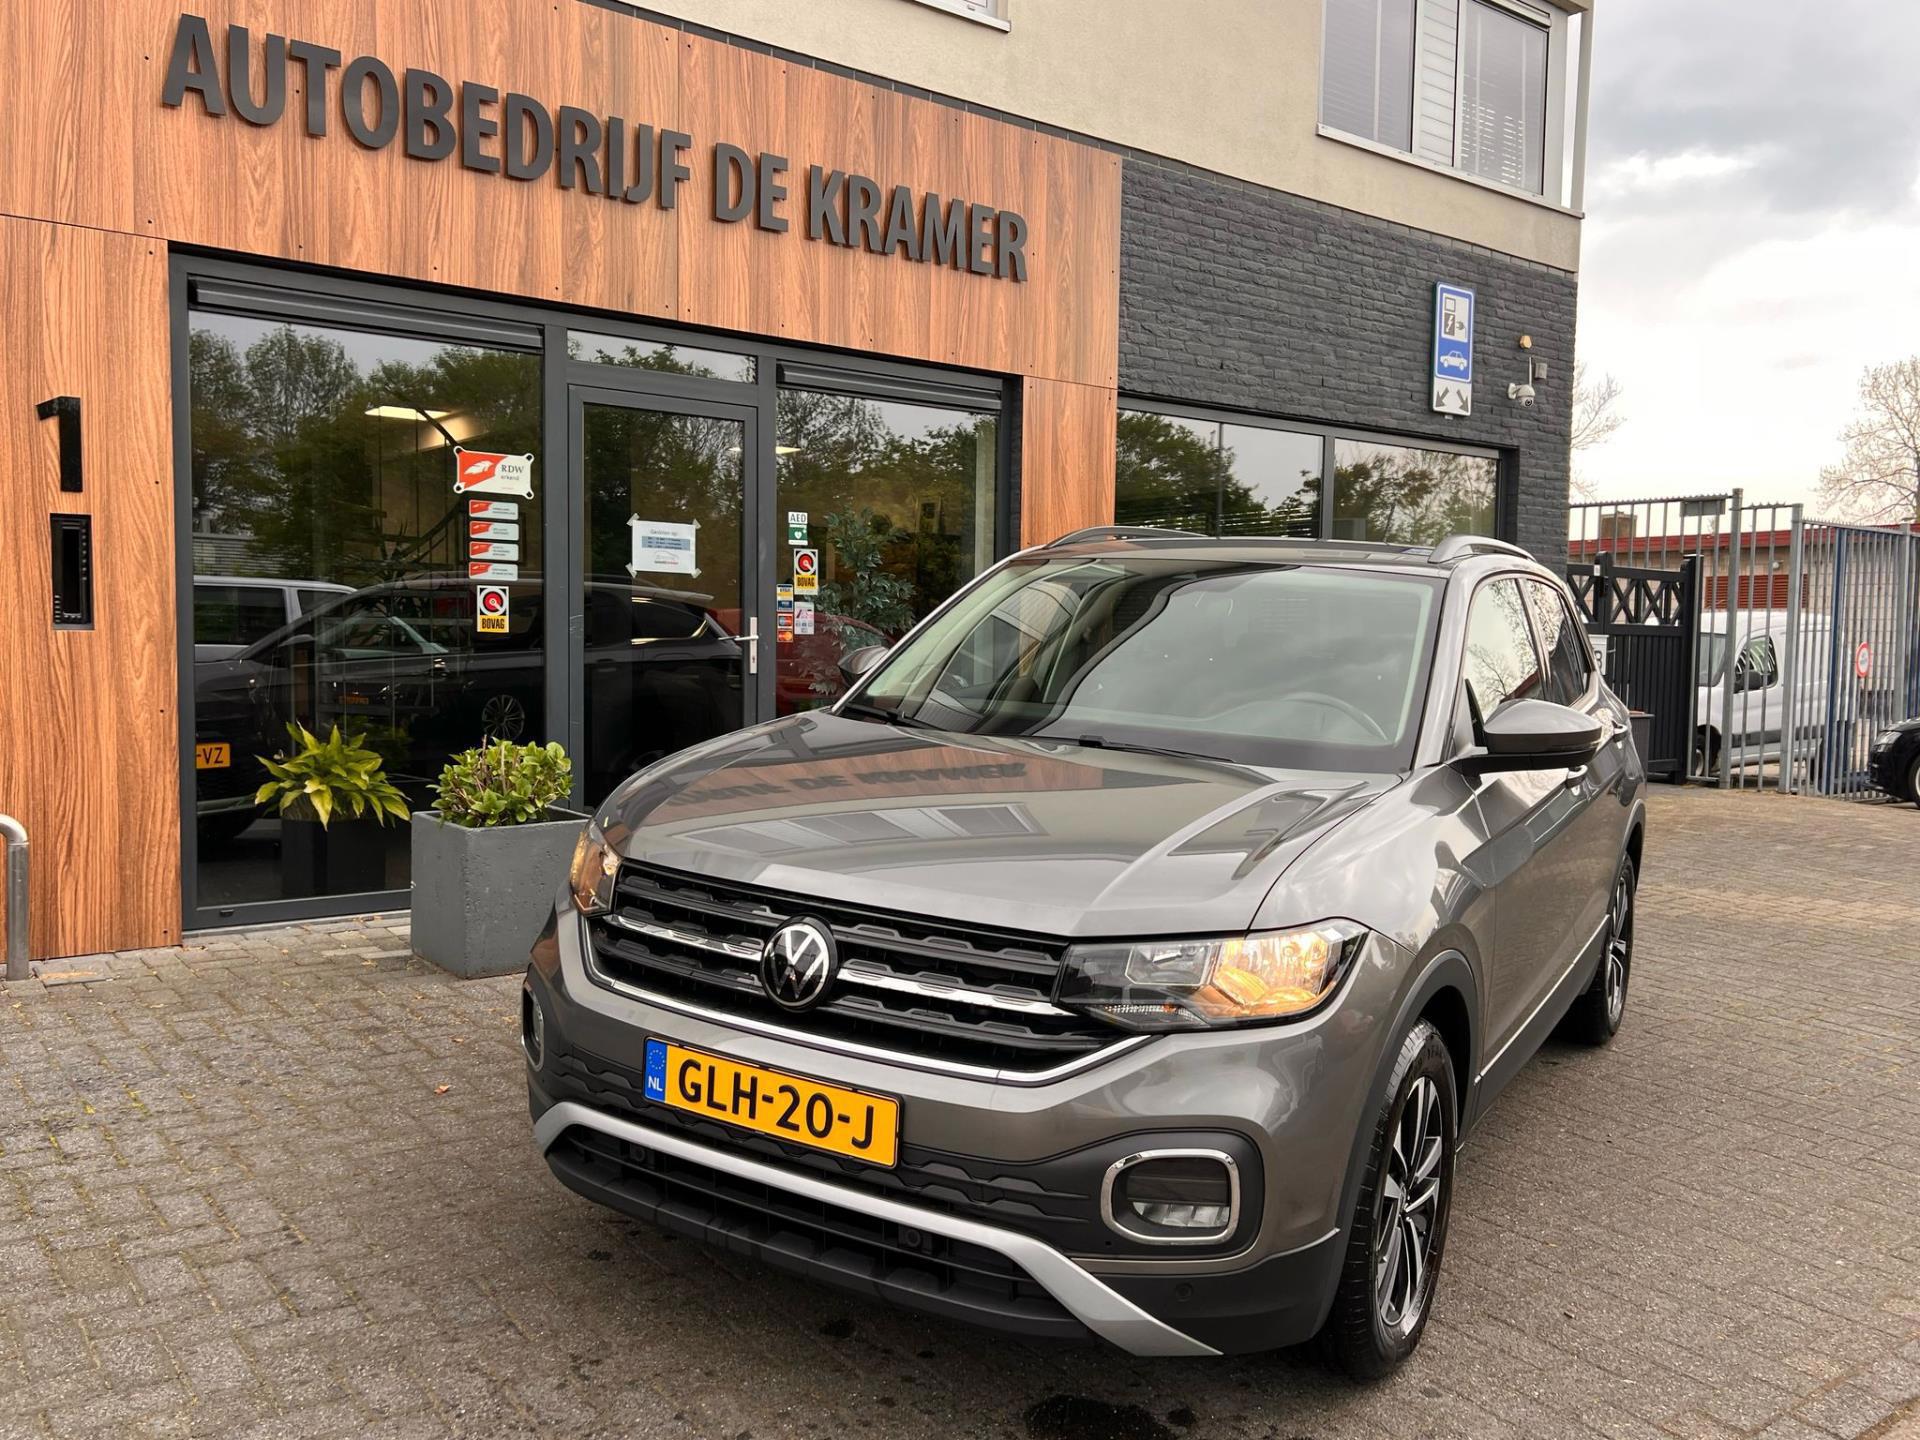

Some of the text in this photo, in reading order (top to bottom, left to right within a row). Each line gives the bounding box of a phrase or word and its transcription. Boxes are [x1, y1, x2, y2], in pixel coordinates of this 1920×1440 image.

[162, 14, 1029, 284] AUTOBEDRIJF DE KRAMER
[35, 396, 83, 493] 1
[501, 464, 525, 473] RDW
[790, 513, 806, 522] AED
[797, 577, 815, 587] BOVAG
[482, 618, 504, 629] BOVAG
[648, 1075, 663, 1092] NL
[678, 1058, 875, 1150] GLH-20-J
